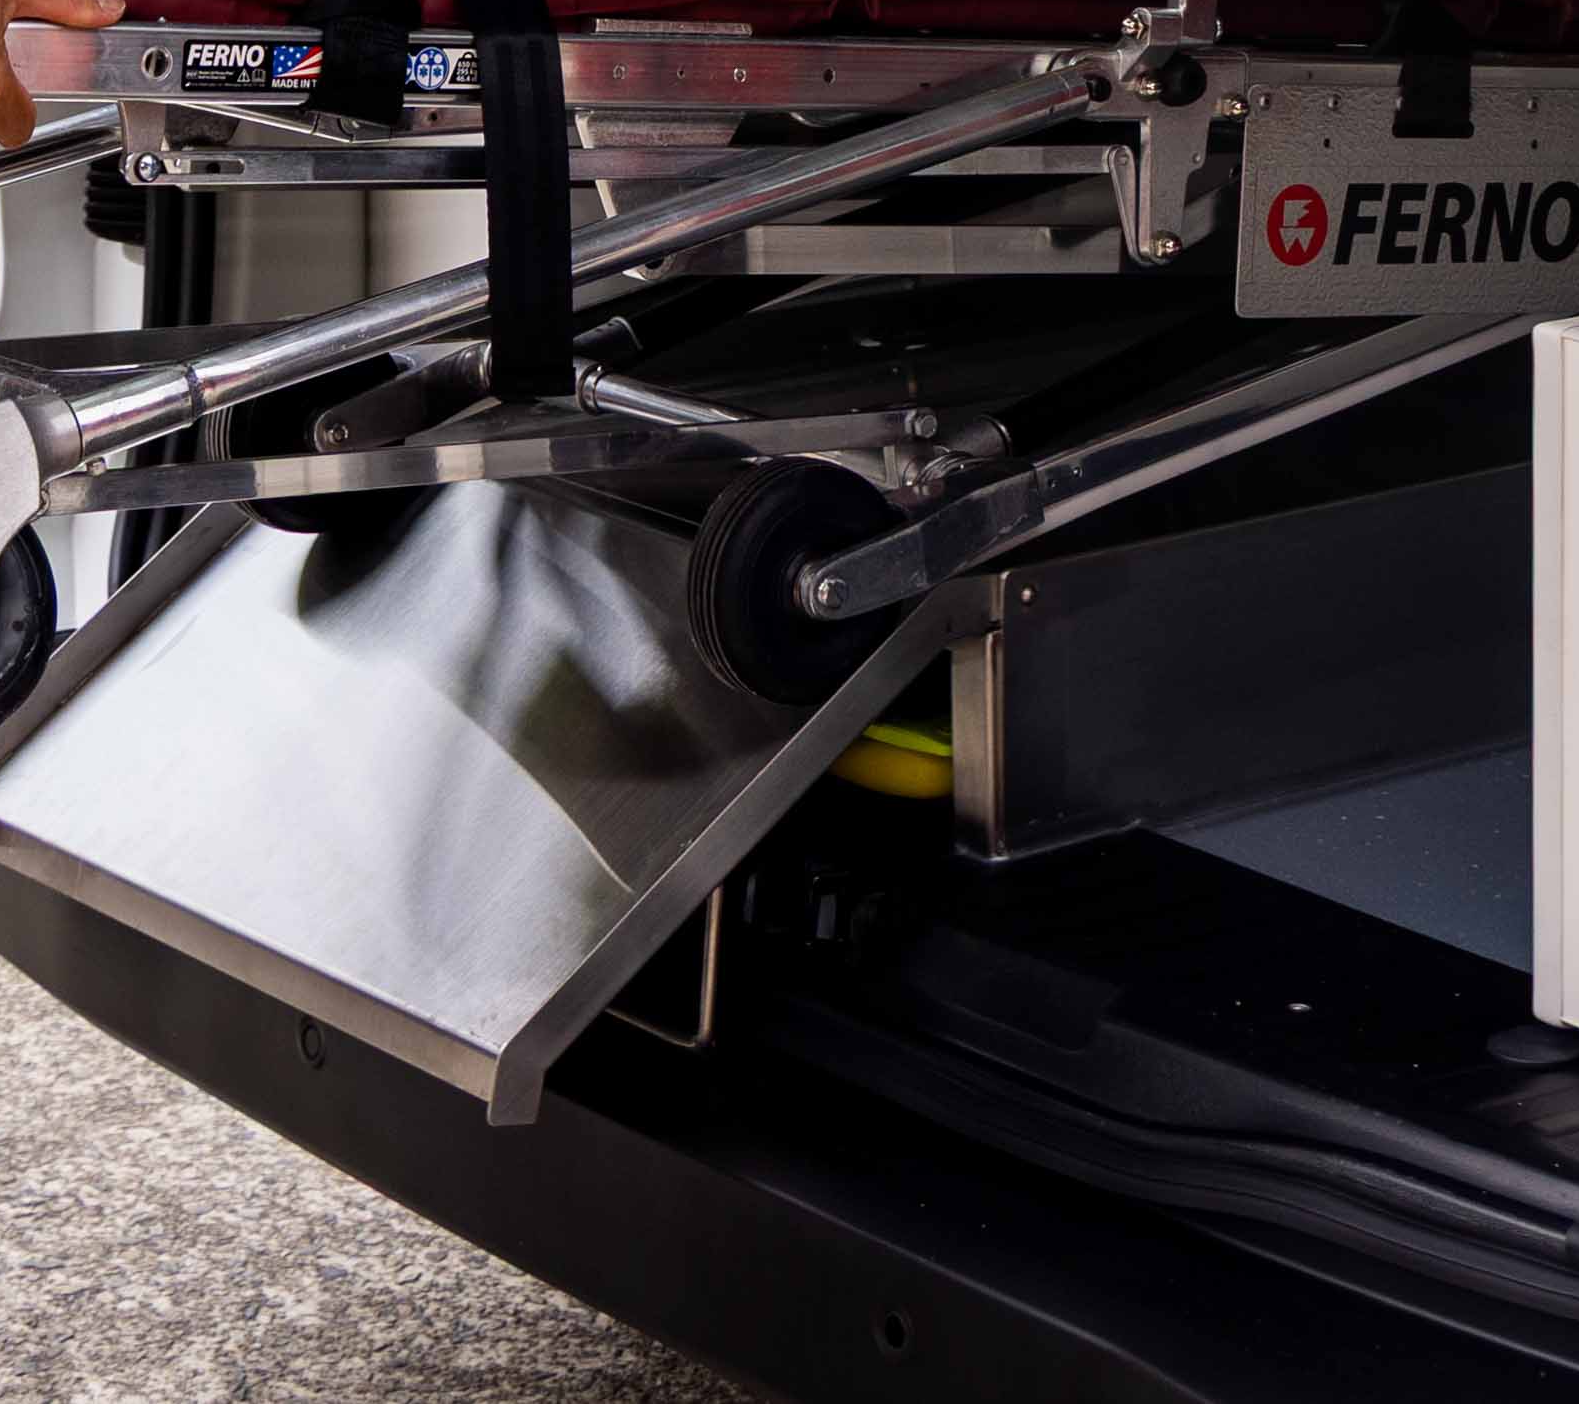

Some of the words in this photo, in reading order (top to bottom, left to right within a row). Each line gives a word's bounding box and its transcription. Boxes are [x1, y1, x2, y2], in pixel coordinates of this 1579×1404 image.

[186, 43, 266, 68] FERNO
[271, 78, 299, 89] MADE
[300, 78, 310, 89] IN
